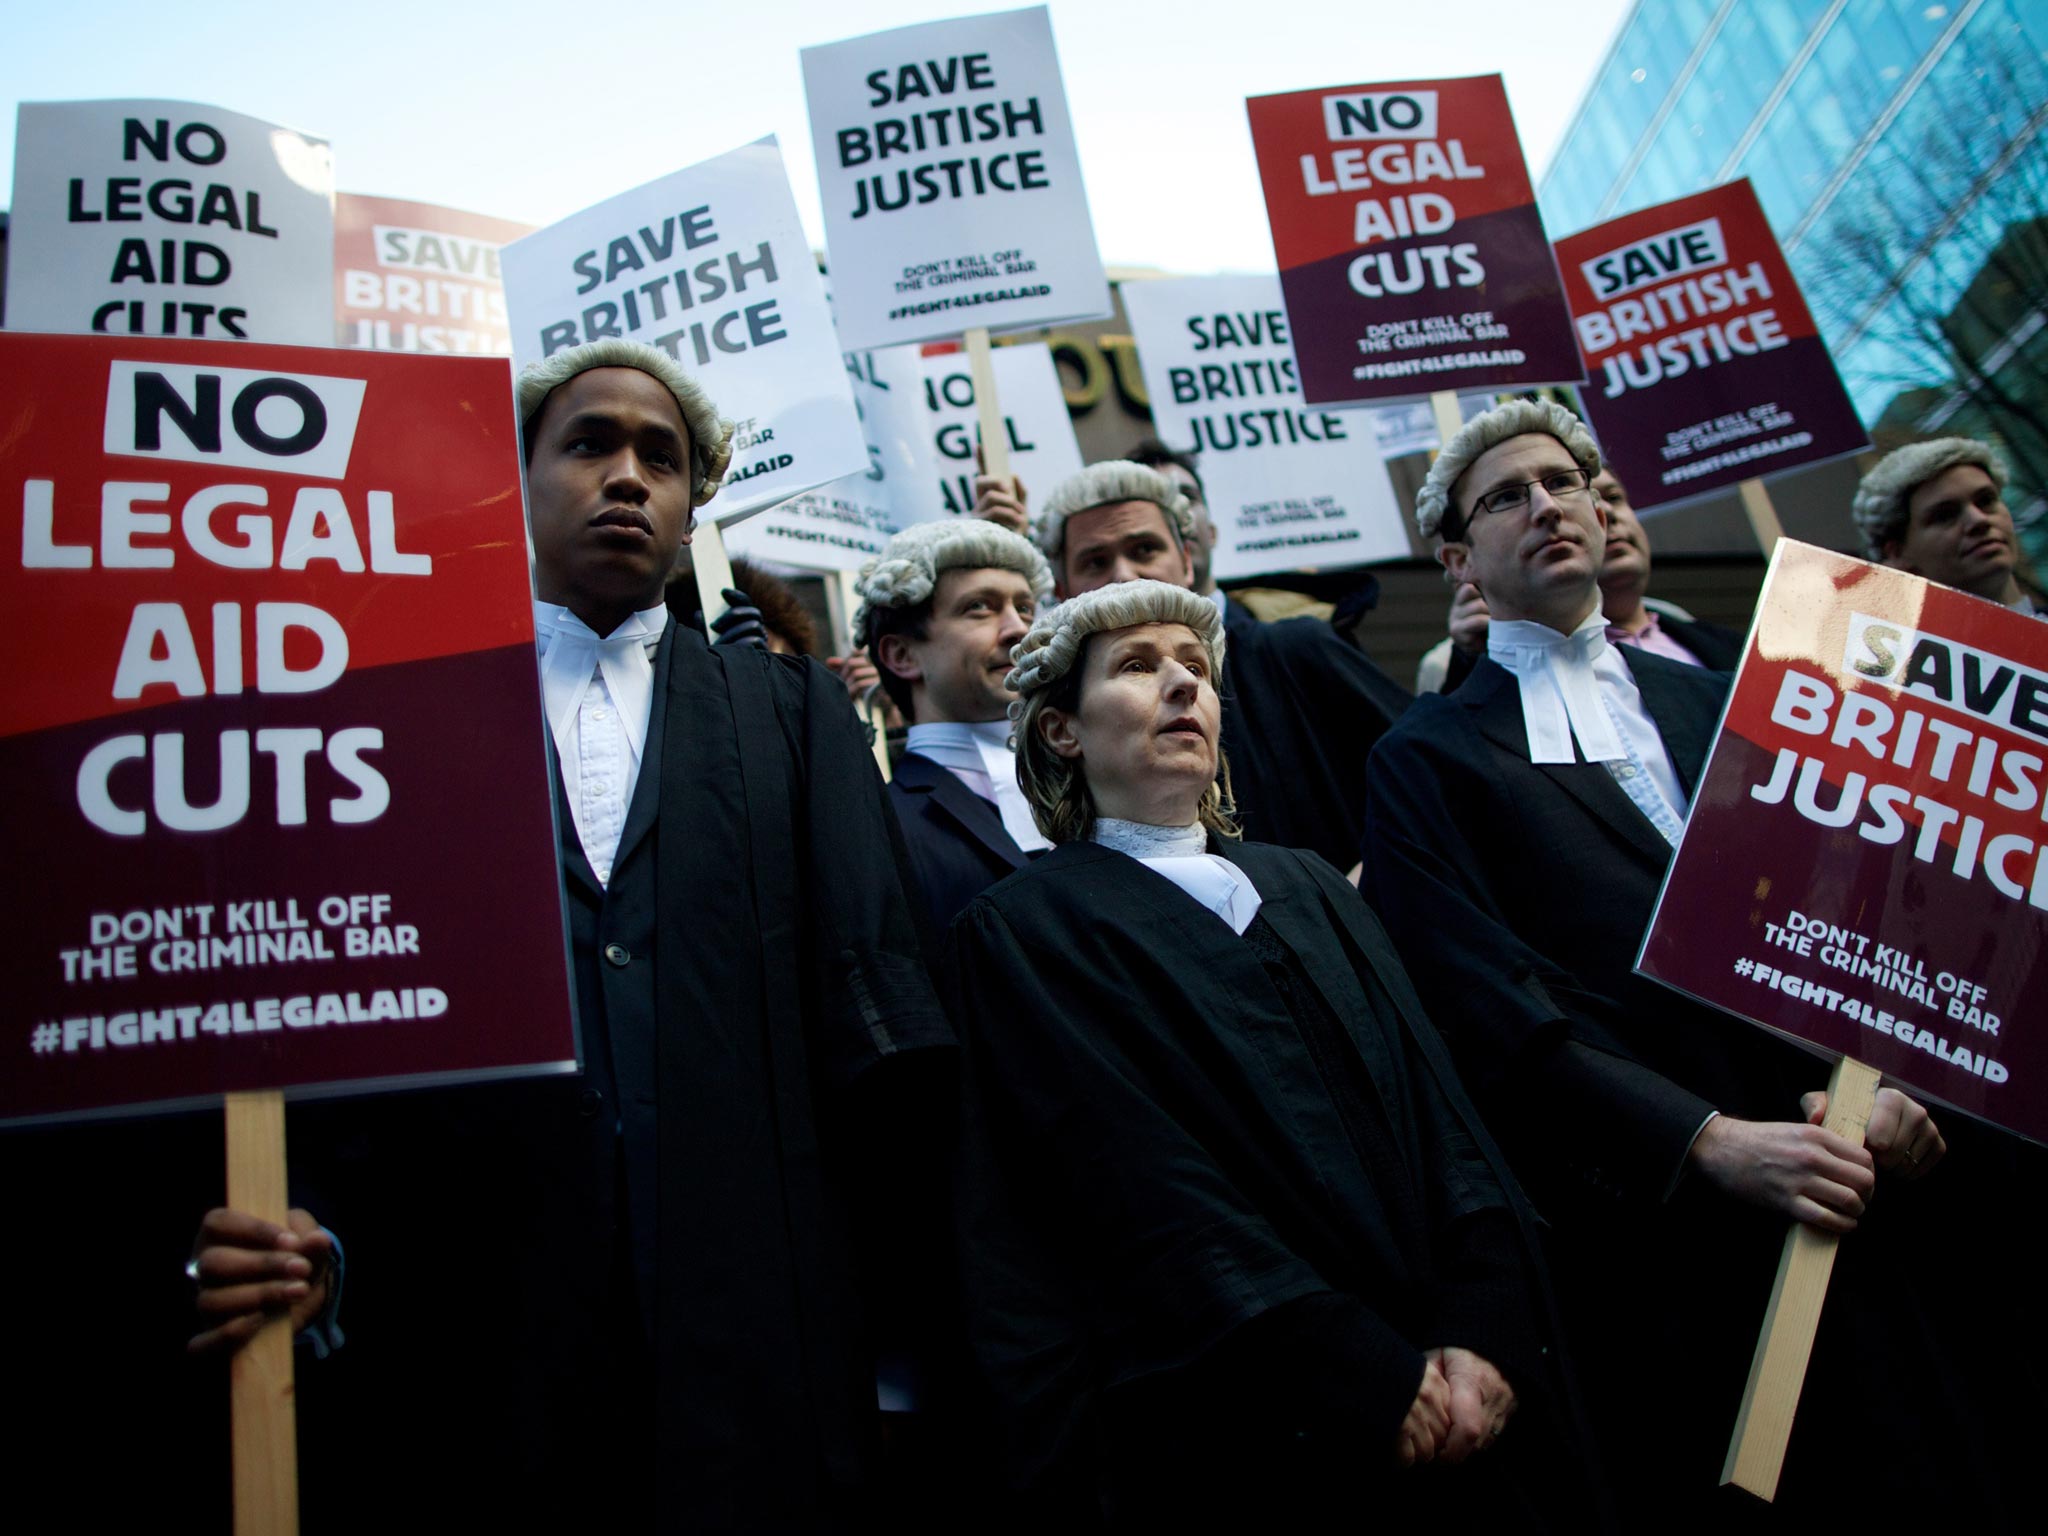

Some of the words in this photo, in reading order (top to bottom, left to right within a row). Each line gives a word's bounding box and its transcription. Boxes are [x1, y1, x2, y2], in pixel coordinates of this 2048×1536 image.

[866, 53, 995, 108] SAVE
[123, 118, 227, 166] NO
[836, 98, 1045, 168] BRITISH
[1336, 95, 1423, 137] NO
[851, 150, 1051, 219] JUSTICE
[1301, 140, 1485, 196] LEGAL
[68, 177, 279, 239] LEGAL
[1354, 193, 1456, 243] AID
[110, 238, 232, 286] AID
[573, 204, 720, 296] SAVE
[894, 279, 924, 294] THE
[928, 266, 1000, 288] CRIMINAL
[1005, 260, 1037, 276] BAR
[903, 260, 951, 280] DON'T
[955, 254, 988, 270] KILL
[992, 249, 1023, 264] OFF
[1347, 244, 1486, 298] CUTS
[1595, 230, 1716, 294] SAVE
[345, 268, 510, 328] BRITIS
[889, 285, 1052, 321] #FIGHT4LEGALAID
[1366, 319, 1418, 339] DON'T
[1421, 315, 1457, 332] KILL
[1460, 311, 1493, 327] OFF
[1575, 261, 1774, 353] BRITISH
[652, 299, 788, 366] TICE
[1188, 311, 1288, 351] SAVE
[1357, 337, 1392, 354] THE
[1393, 326, 1473, 349] CRIMINAL
[1474, 323, 1510, 341] BAR
[1602, 309, 1790, 399] JUSTICE
[1169, 358, 1297, 404] BRITIS
[1353, 349, 1527, 380] #FIGHT4LEGALAID
[134, 371, 328, 457] NO
[736, 417, 757, 436] FF
[736, 428, 775, 451] BAR
[1189, 408, 1348, 454] JUSTICE
[21, 478, 433, 576] LEGAL
[112, 601, 350, 700] AID
[1853, 624, 2048, 740] SAVE
[1770, 668, 2048, 824] BRITIS
[76, 727, 391, 836] CUTS
[90, 905, 215, 946] DON'T
[227, 899, 309, 934] KILL
[318, 894, 392, 926] OFF
[60, 945, 138, 983] THE
[150, 930, 335, 973] CRIMINAL
[345, 924, 420, 958] BAR
[1764, 922, 1815, 958] THE
[1819, 945, 1940, 1011] CRIMINAL
[1946, 997, 2002, 1037] BAR
[1786, 910, 1870, 955] DON'T
[1875, 943, 1929, 984] KILL
[1935, 971, 1988, 1005] OFF
[31, 987, 449, 1054] #FIGHT4LEGALAID
[1733, 957, 2010, 1084] #FIGHT4LEGALAID
